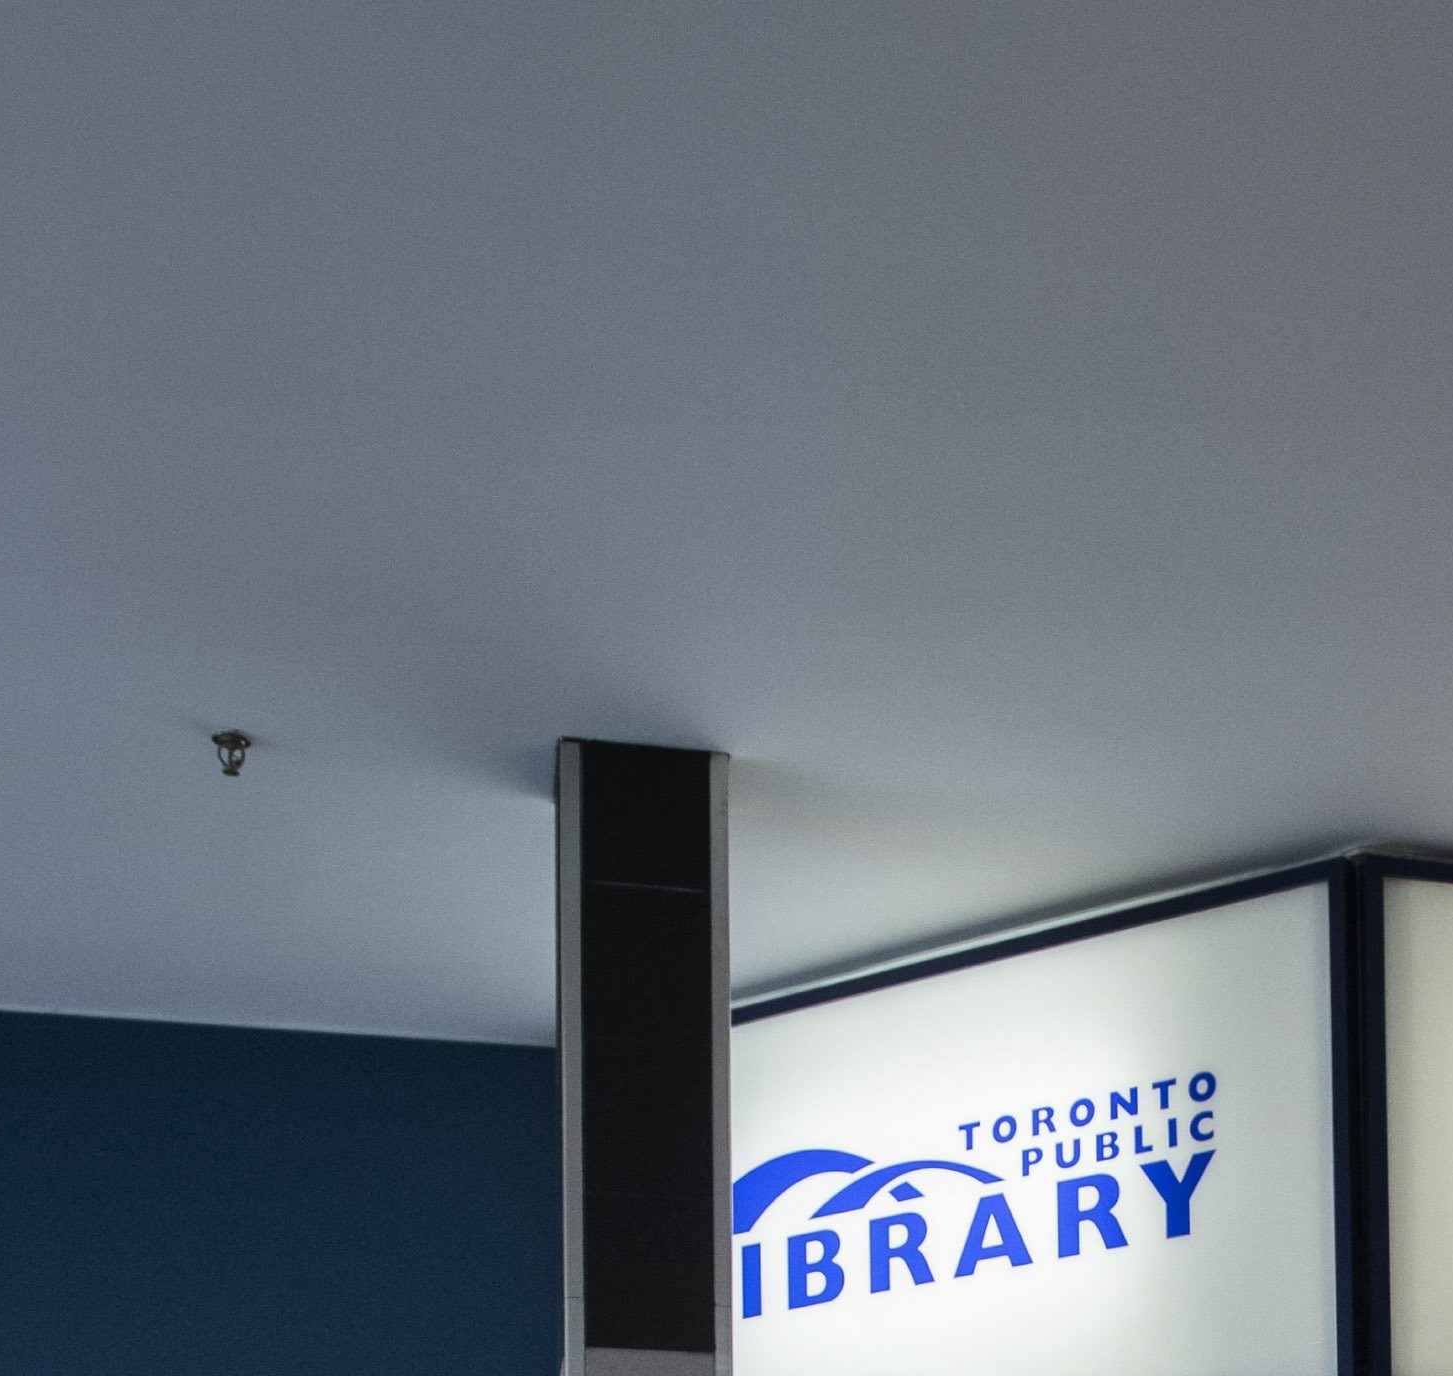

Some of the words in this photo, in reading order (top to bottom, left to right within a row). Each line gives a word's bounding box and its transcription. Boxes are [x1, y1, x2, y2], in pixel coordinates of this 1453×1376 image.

[959, 1071, 1217, 1150] TORONTO
[1022, 1111, 1215, 1177] PUBLIC
[741, 1150, 1217, 1319] IBRARY
